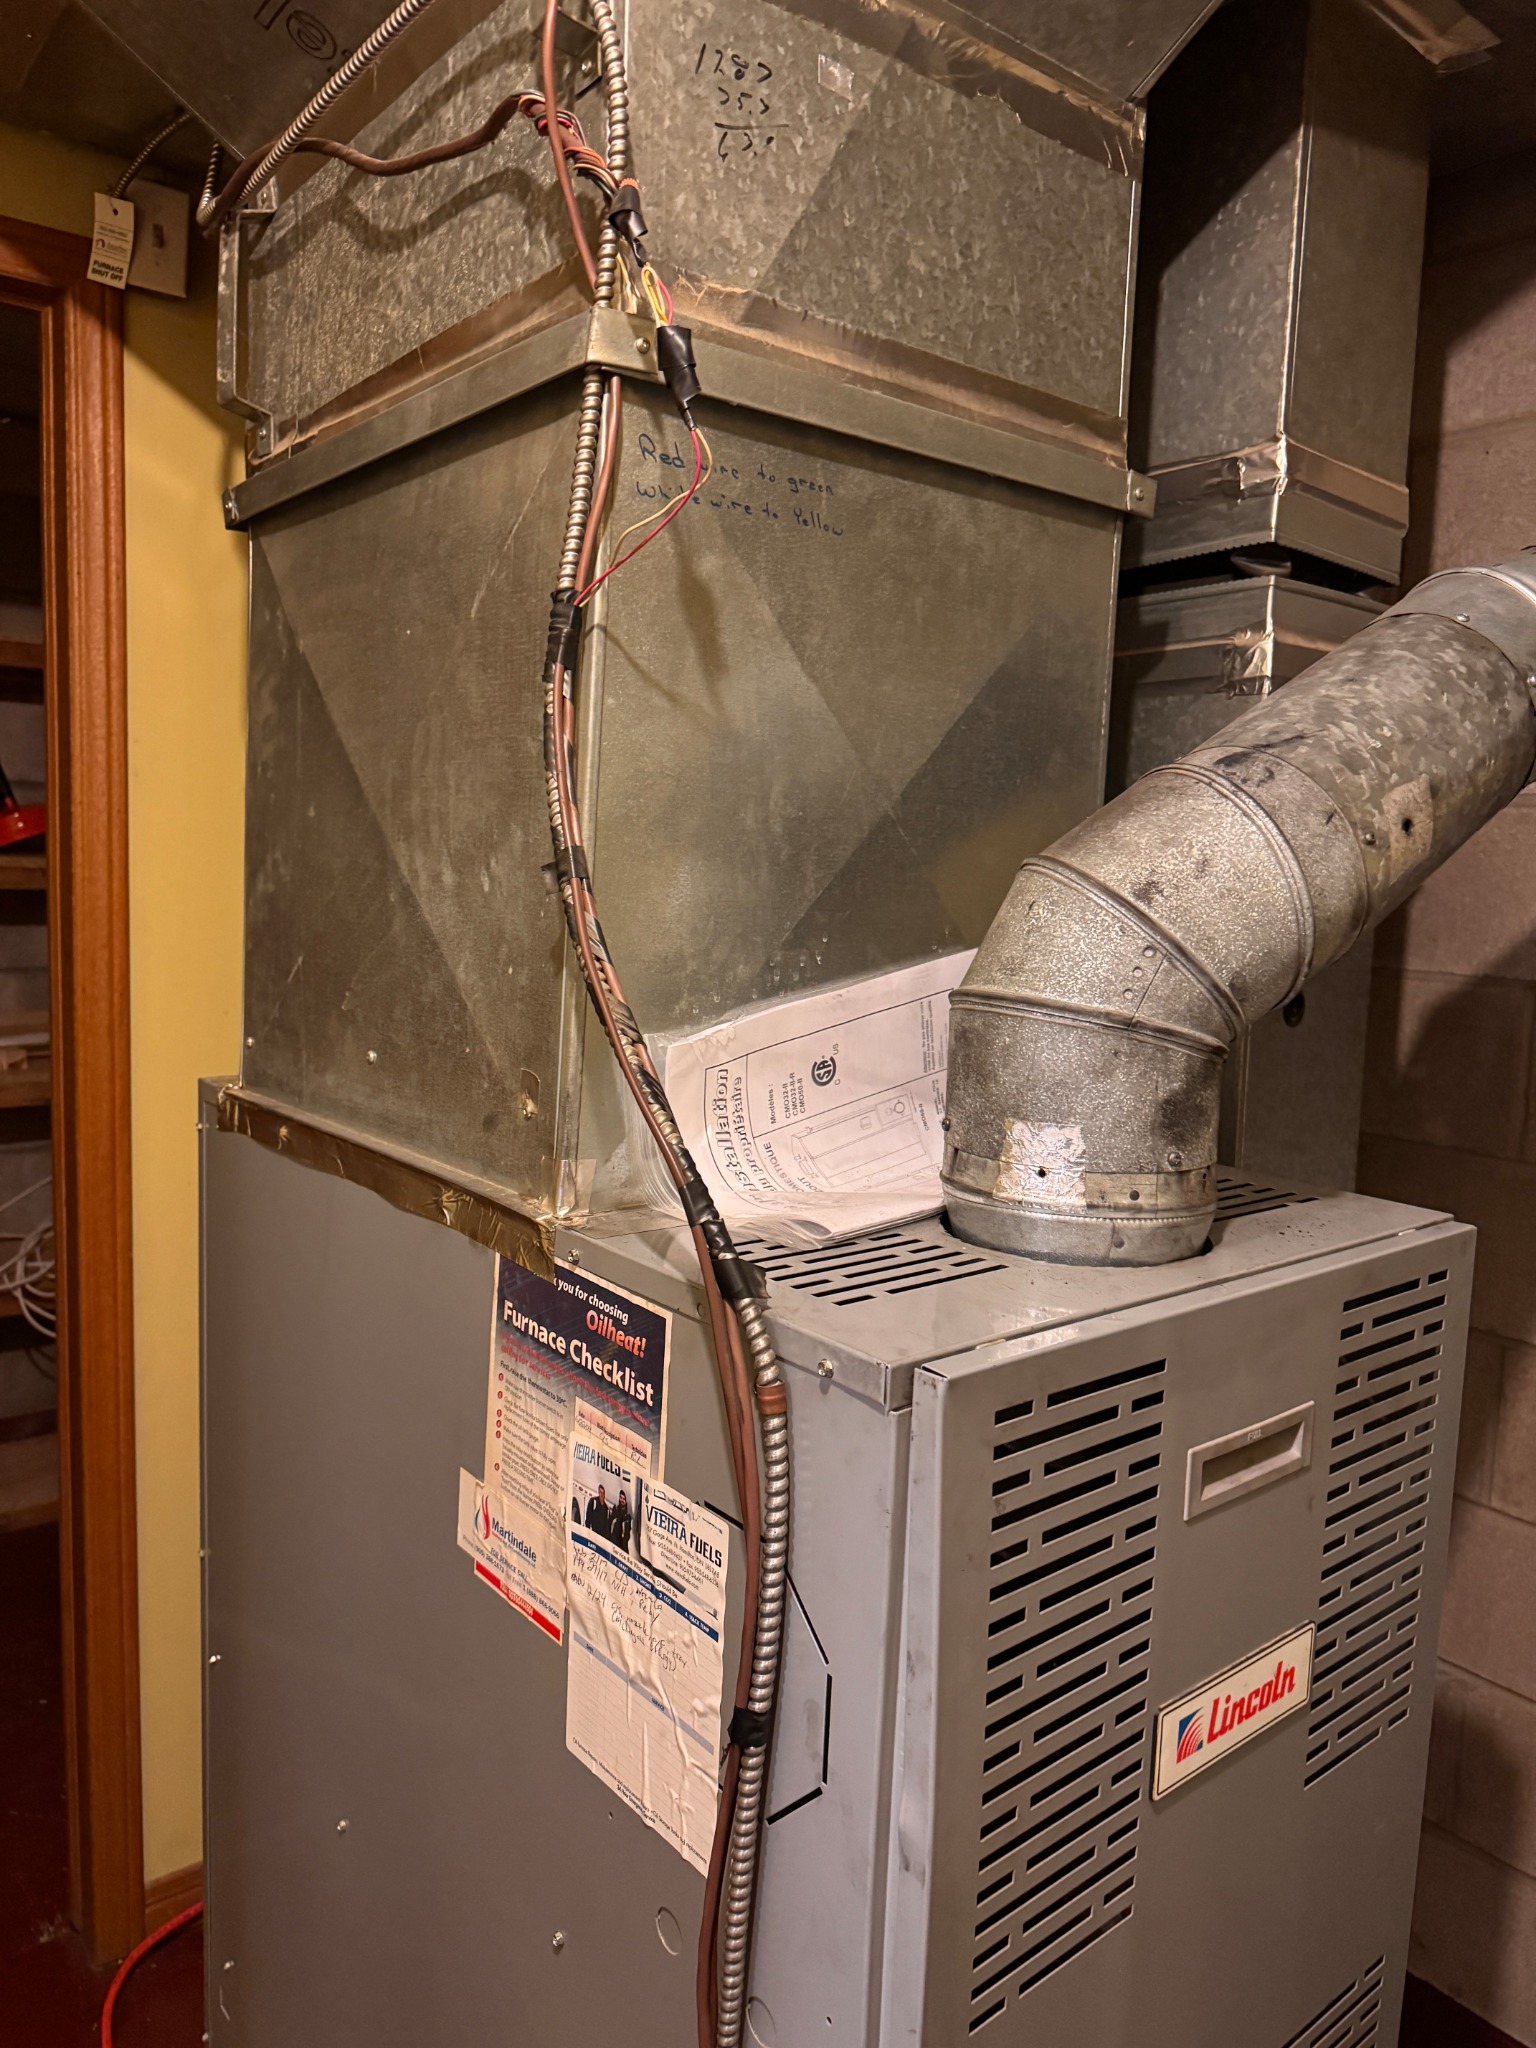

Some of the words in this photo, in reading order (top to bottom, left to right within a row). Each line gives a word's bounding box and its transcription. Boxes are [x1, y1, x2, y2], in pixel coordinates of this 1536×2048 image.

[91, 267, 109, 278] SHUT
[110, 271, 124, 282] OFF
[93, 260, 124, 275] FURNACE
[638, 433, 686, 469] Red
[757, 464, 776, 482] to
[788, 476, 834, 495] green
[711, 494, 753, 515] wire
[762, 502, 778, 520] to
[794, 508, 844, 536] Yellow
[832, 1043, 840, 1056] US
[558, 1279, 574, 1295] you
[575, 1285, 588, 1301] for
[589, 1294, 629, 1326] choosing
[503, 1300, 567, 1355] Furnace
[569, 1339, 655, 1407] Checklist
[586, 1310, 647, 1359] Oilheat!
[492, 1517, 537, 1562] Martindale
[645, 1504, 688, 1545] VIEIRA
[690, 1533, 722, 1568] FUELS
[1206, 1660, 1296, 1744] Lincoln
